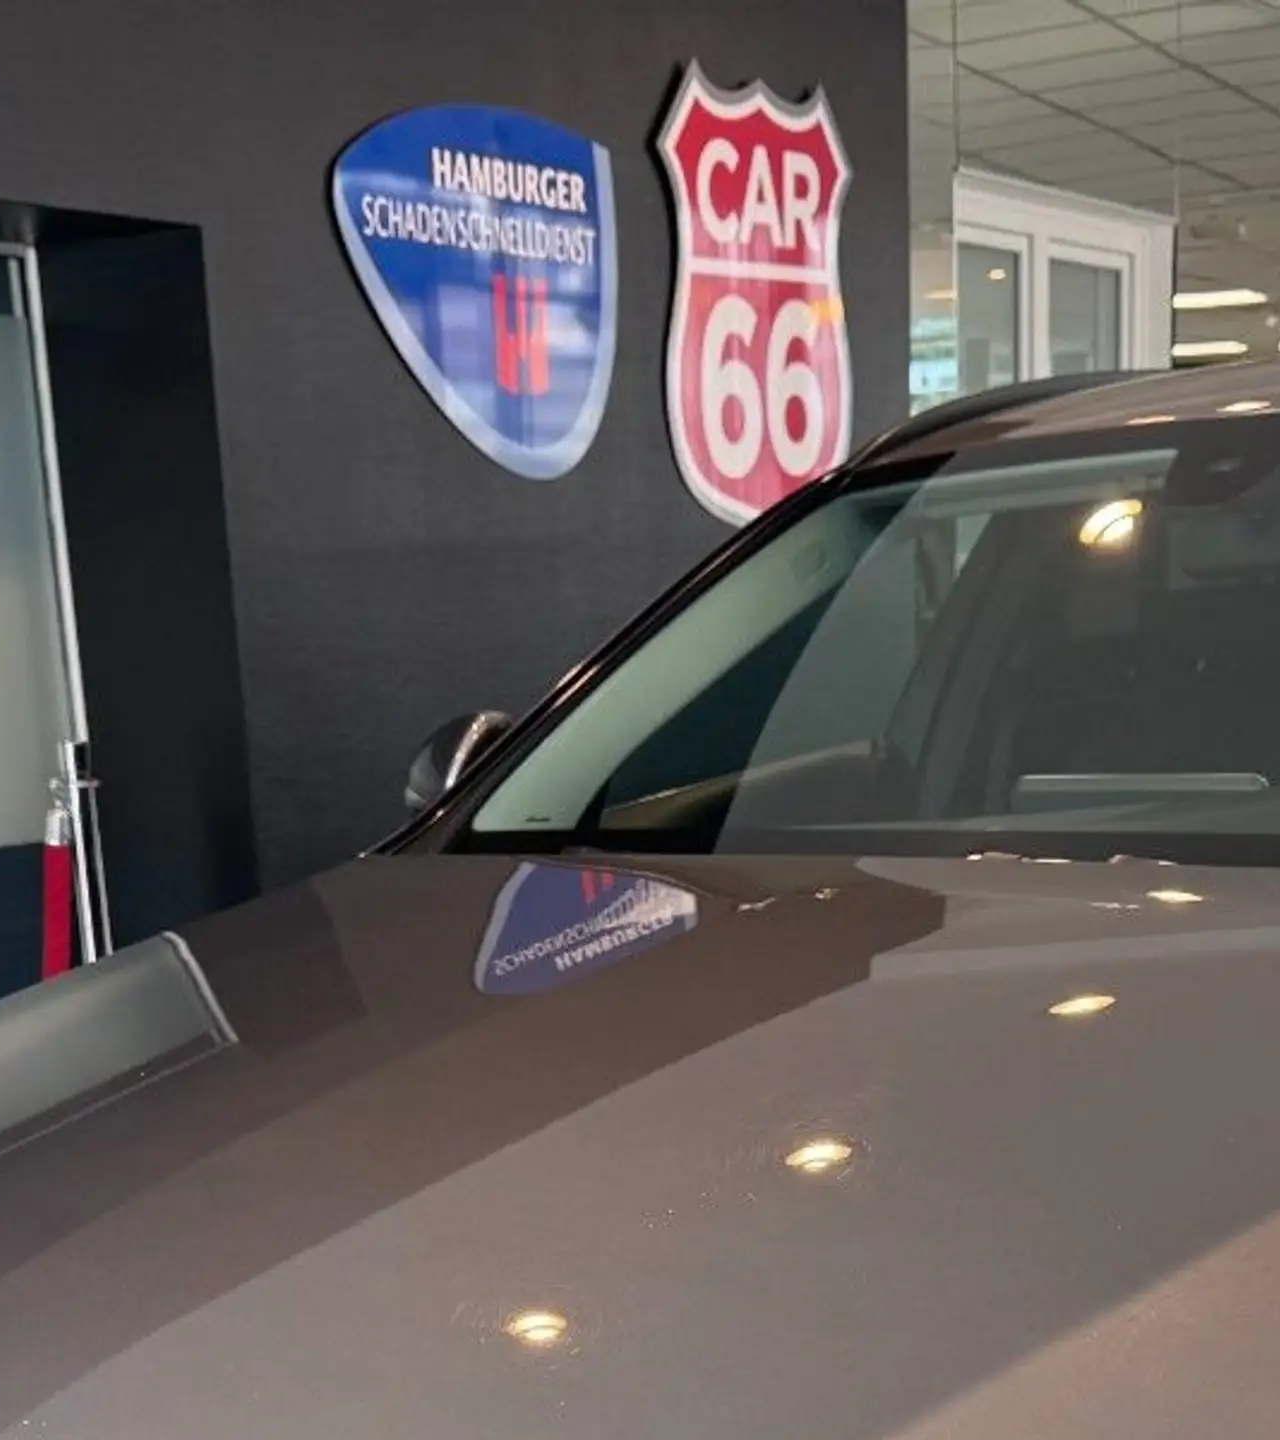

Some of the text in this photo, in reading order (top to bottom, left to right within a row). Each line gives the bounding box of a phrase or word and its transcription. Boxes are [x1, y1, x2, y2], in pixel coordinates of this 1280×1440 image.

[431, 146, 588, 214] HAMBURGER
[696, 137, 822, 252] CAR
[361, 193, 596, 266] SCHADENSCHNELLDIENST
[701, 294, 825, 478] 66
